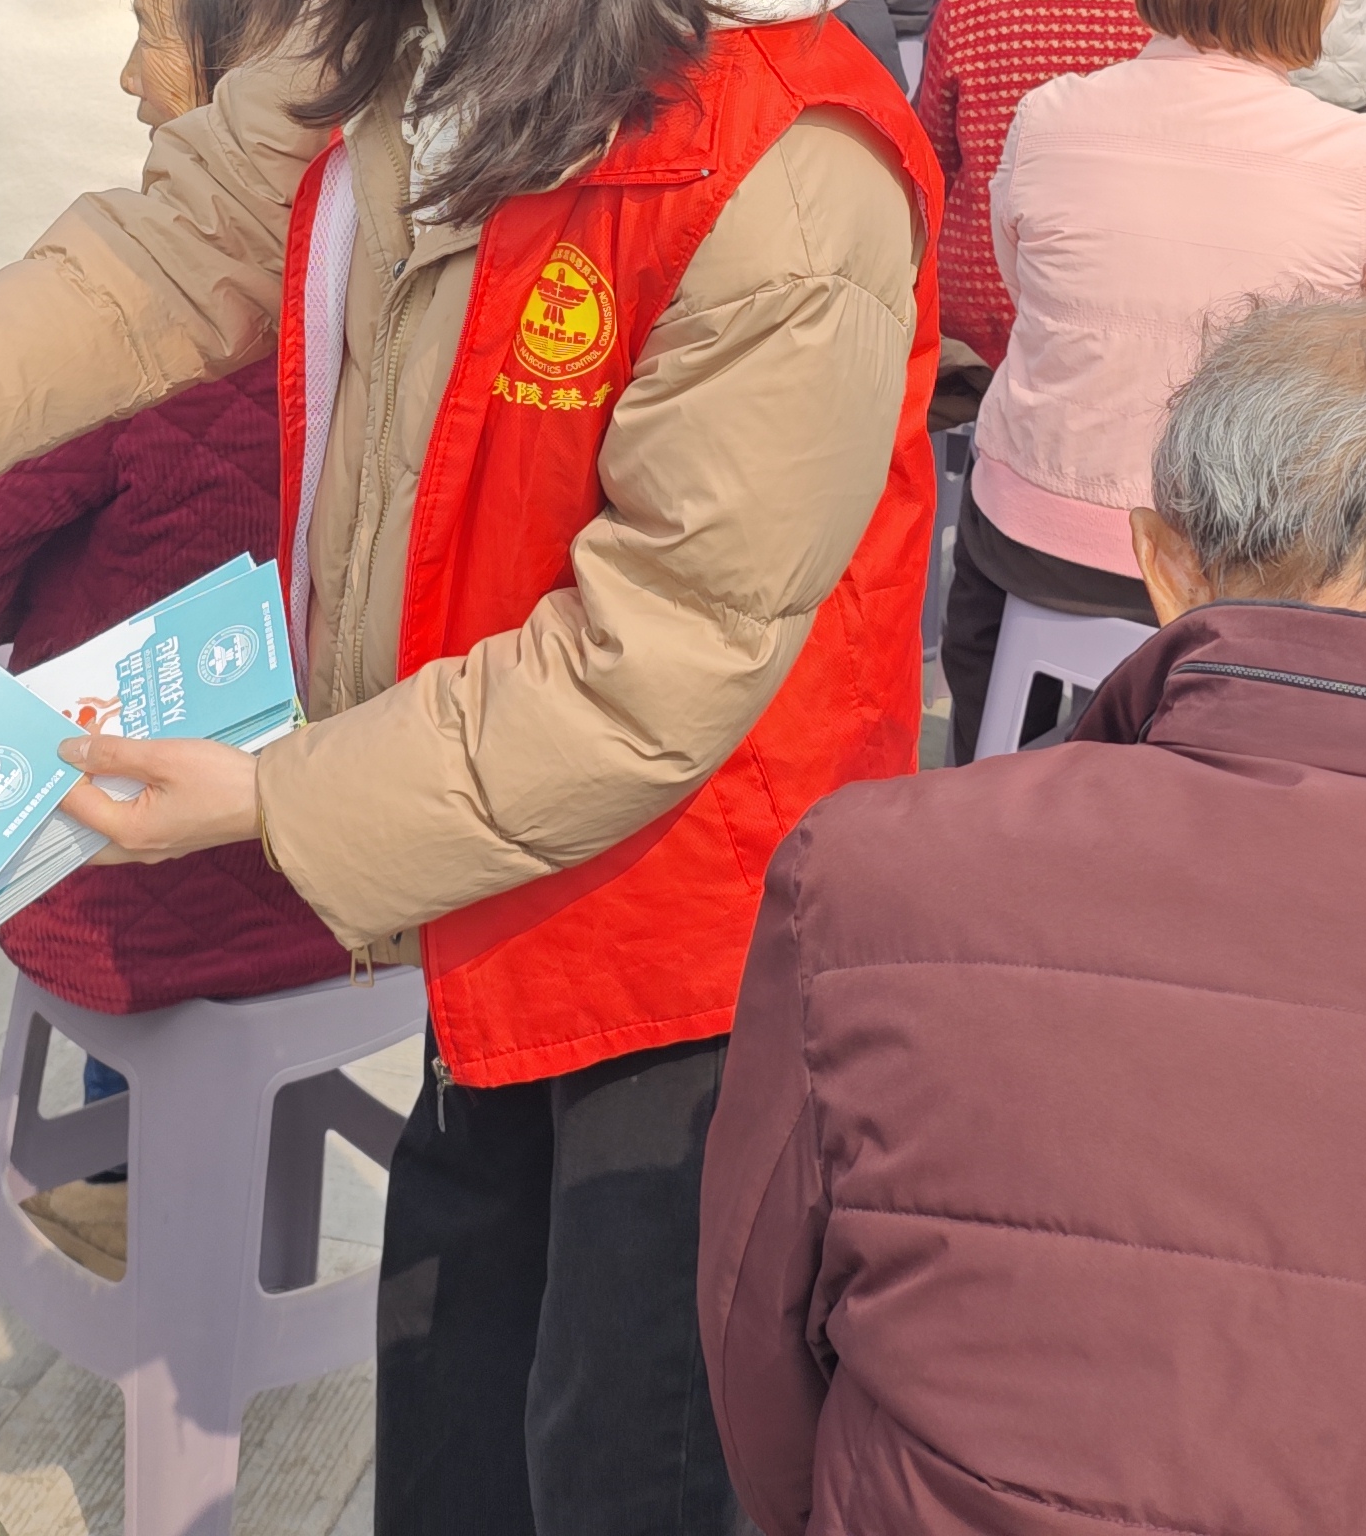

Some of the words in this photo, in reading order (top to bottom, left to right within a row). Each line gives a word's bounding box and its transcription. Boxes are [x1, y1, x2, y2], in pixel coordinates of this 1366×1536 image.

[519, 346, 562, 375] NARCOTICS
[565, 349, 602, 373] CONTROL
[120, 651, 151, 740] 拒绝毒品
[155, 635, 187, 726] 从我做起
